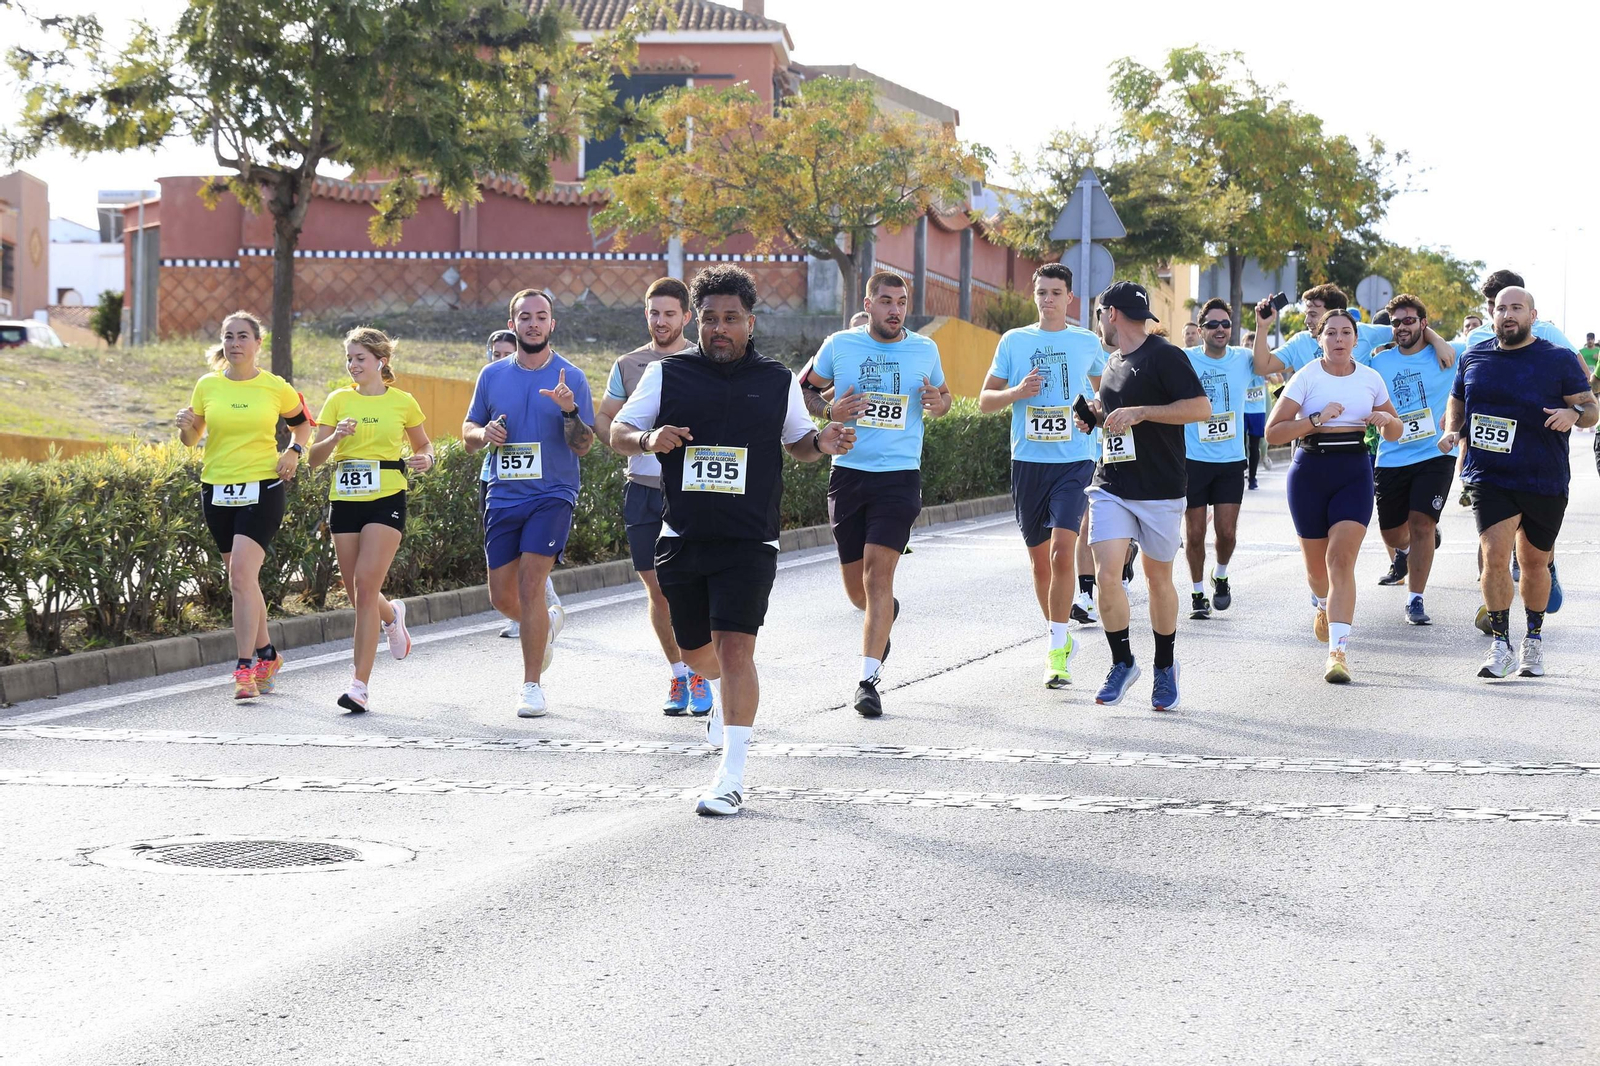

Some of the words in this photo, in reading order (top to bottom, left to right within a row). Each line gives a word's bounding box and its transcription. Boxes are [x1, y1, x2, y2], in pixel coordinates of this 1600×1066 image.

[865, 403, 903, 419] 288
[1030, 418, 1067, 431] 143
[1208, 422, 1228, 434] 20
[1409, 421, 1419, 432] 3
[1475, 426, 1509, 443] 259
[501, 455, 534, 469] 557
[691, 461, 739, 480] 195
[340, 472, 372, 486] 481
[223, 483, 247, 496] 47
